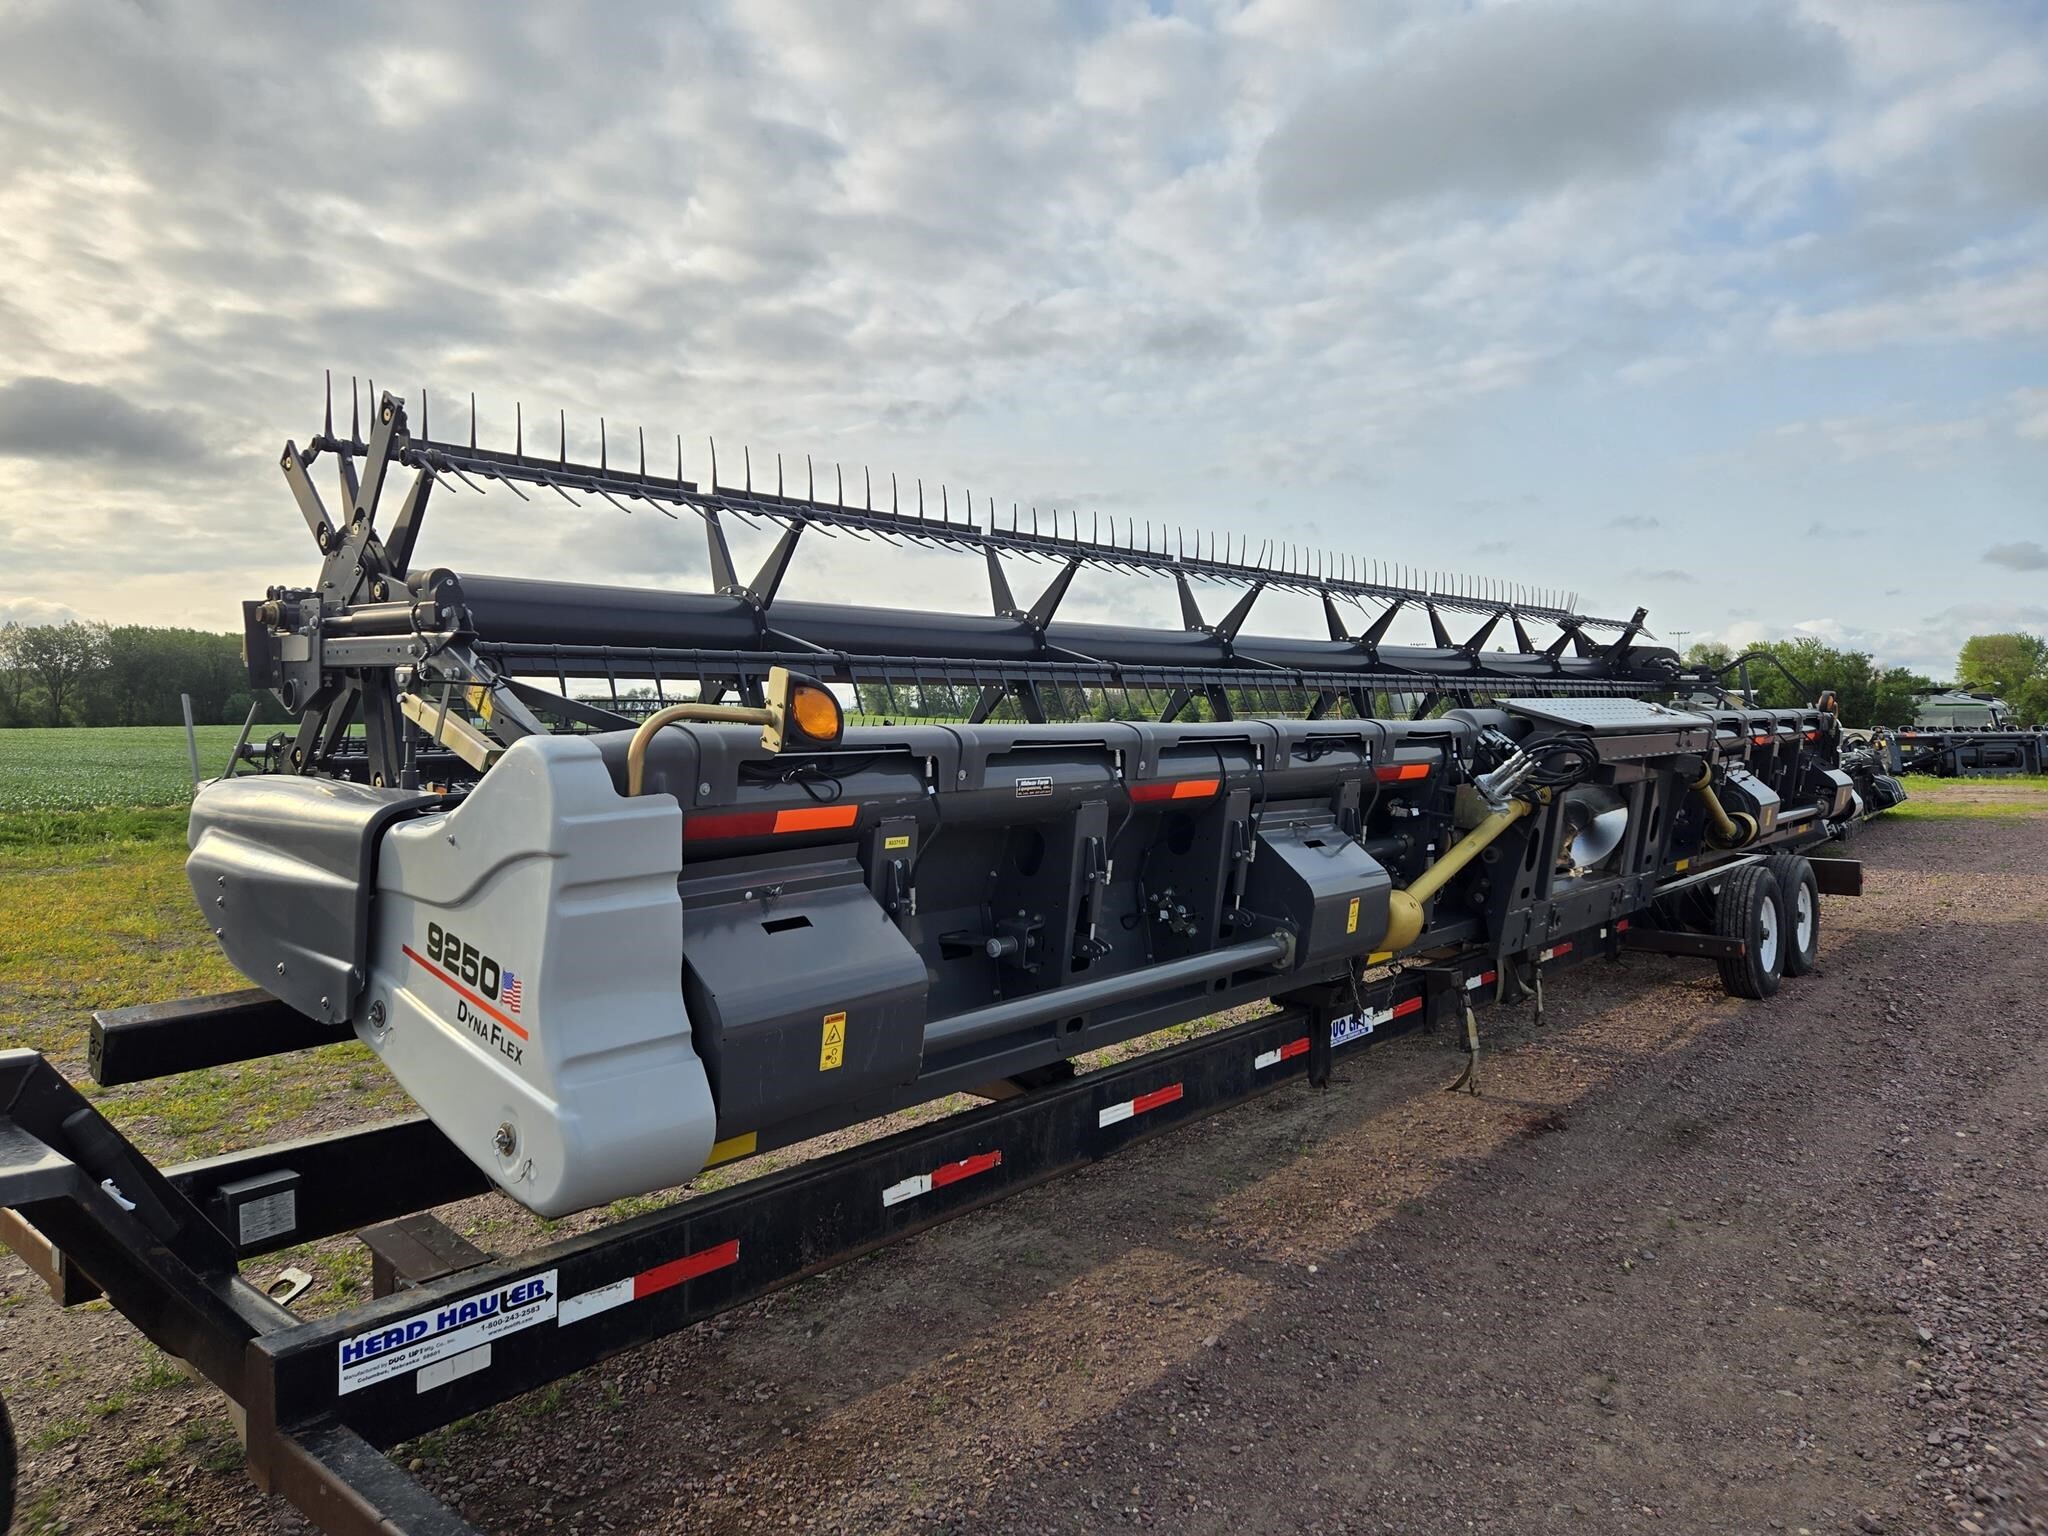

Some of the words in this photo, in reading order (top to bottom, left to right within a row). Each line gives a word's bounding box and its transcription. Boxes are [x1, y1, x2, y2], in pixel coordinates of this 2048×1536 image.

[426, 921, 500, 1001] 9250
[1332, 1018, 1346, 1038] UO
[342, 1320, 428, 1364] HEAD
[437, 1279, 545, 1331] HAULER
[481, 1305, 540, 1331] 1-800-243-2583
[343, 1363, 380, 1381] Manufactured
[381, 1361, 388, 1369] by
[388, 1355, 406, 1365] DUO
[408, 1348, 424, 1358] LIFT
[357, 1370, 390, 1383] Columbus,
[391, 1358, 420, 1371] Nebraska
